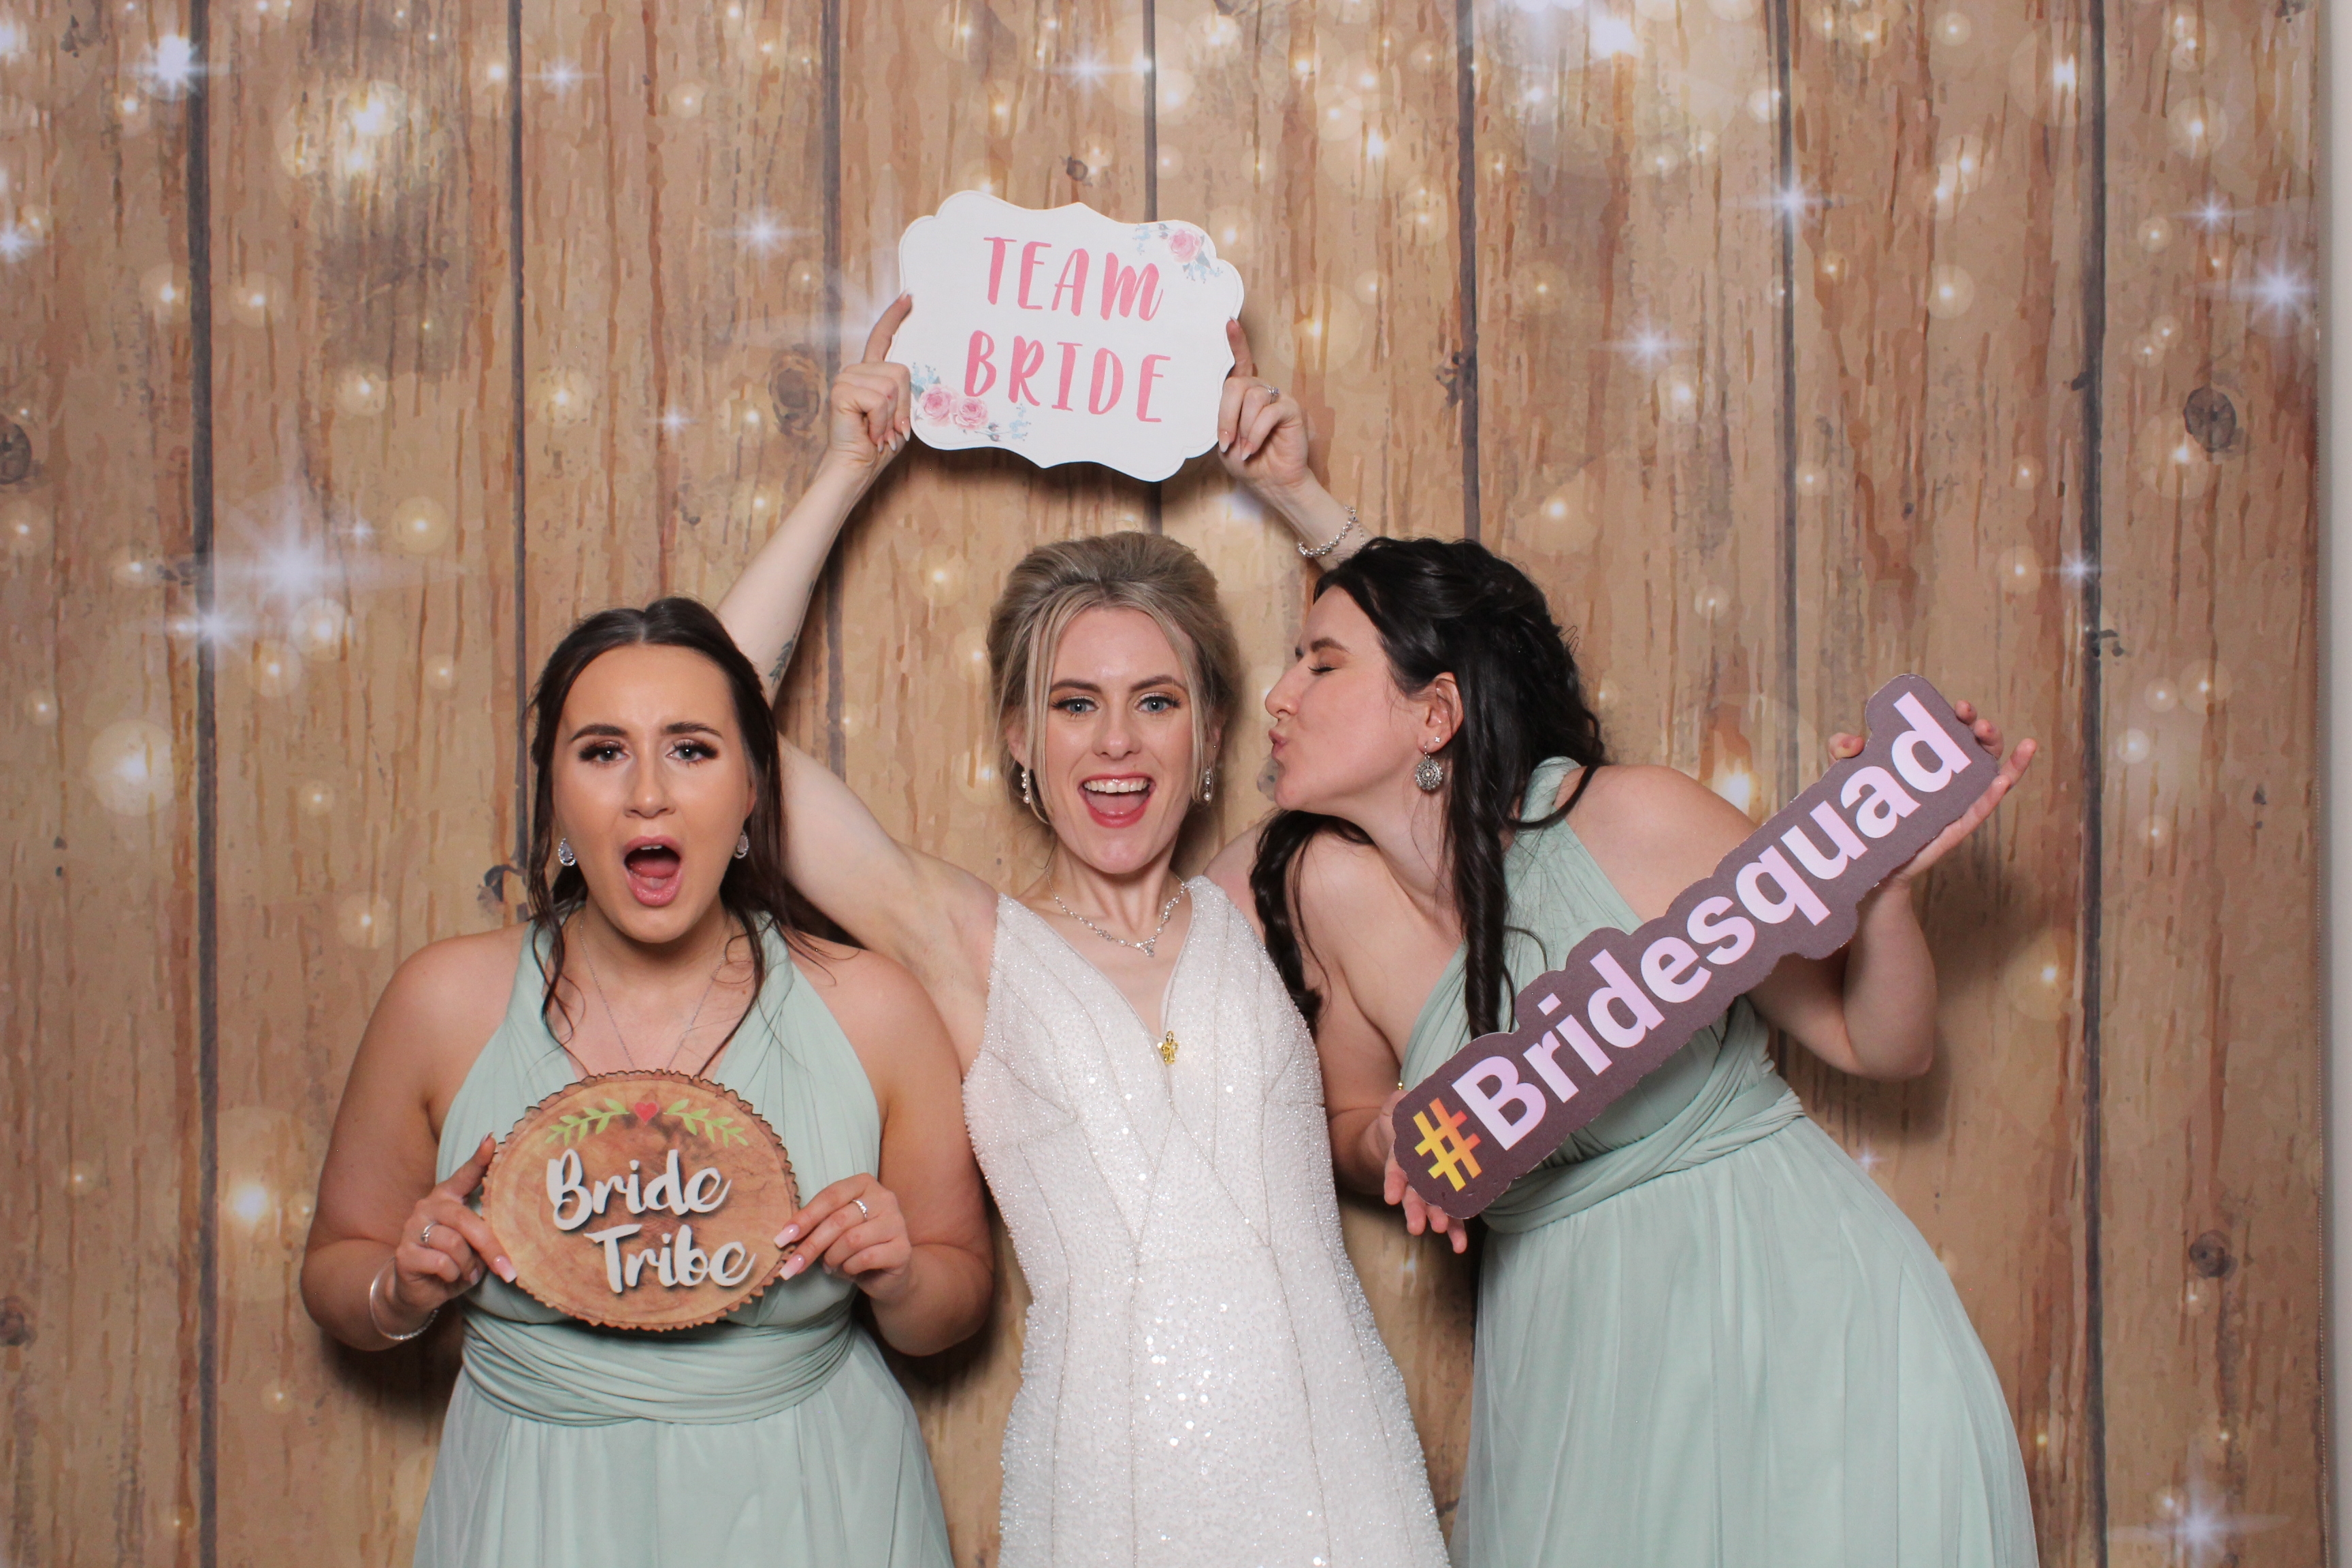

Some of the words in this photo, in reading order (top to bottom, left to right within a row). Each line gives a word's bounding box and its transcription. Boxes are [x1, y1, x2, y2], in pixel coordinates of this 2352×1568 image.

[983, 236, 1164, 321] TEAM
[964, 330, 1171, 423] BRIDE
[1414, 691, 1972, 1192] #Bridesquad
[546, 1148, 732, 1230] Bride
[583, 1224, 756, 1293] Tribe
